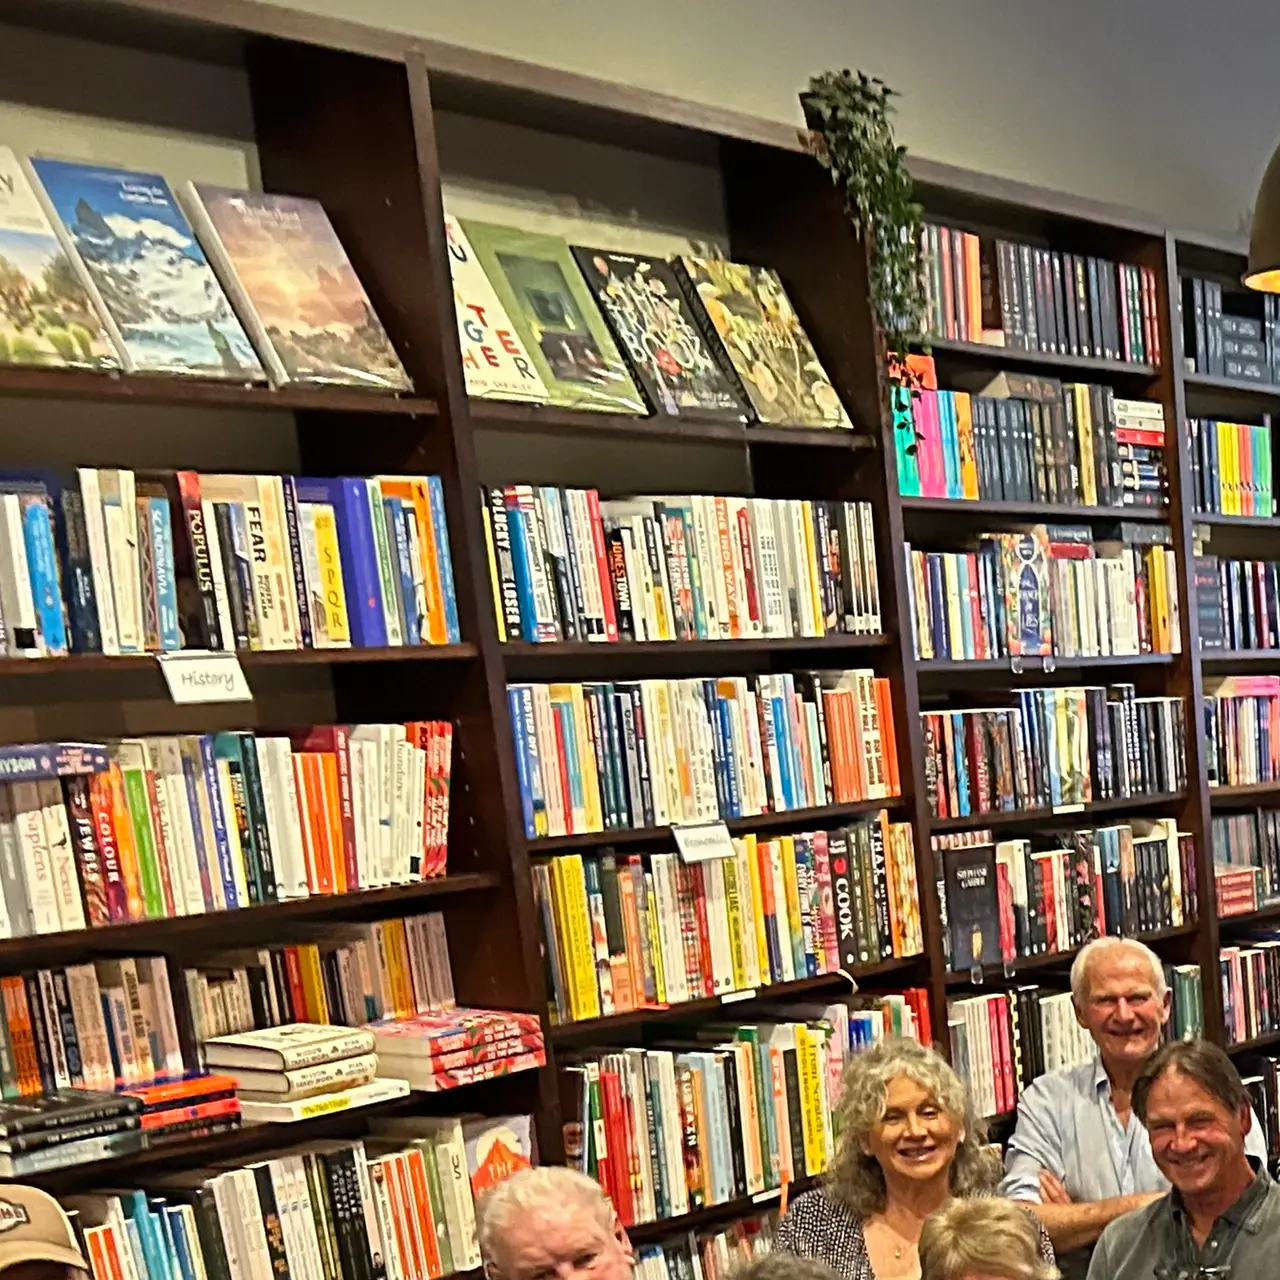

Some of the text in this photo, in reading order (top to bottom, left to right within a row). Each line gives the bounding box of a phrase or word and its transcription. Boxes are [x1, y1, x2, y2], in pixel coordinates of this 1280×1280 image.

[153, 508, 167, 596] SCANDINAVIA
[186, 507, 215, 592] POPULUS
[245, 505, 269, 564] FEAR
[492, 505, 520, 625] LUCKY LOSER
[716, 501, 736, 602] THE INDI WAY
[611, 539, 631, 612] JONESTOWN
[181, 668, 235, 692] History
[522, 689, 536, 733] RUSTED
[24, 810, 49, 883] Sapiens
[57, 855, 74, 906] Nexus
[76, 816, 99, 884] JEWELS
[97, 810, 119, 884] COLOUR
[872, 830, 886, 877] THAI
[834, 877, 855, 939] COOK
[799, 1038, 810, 1105] OTTOLENGHI
[808, 1044, 824, 1133] From Scratch
